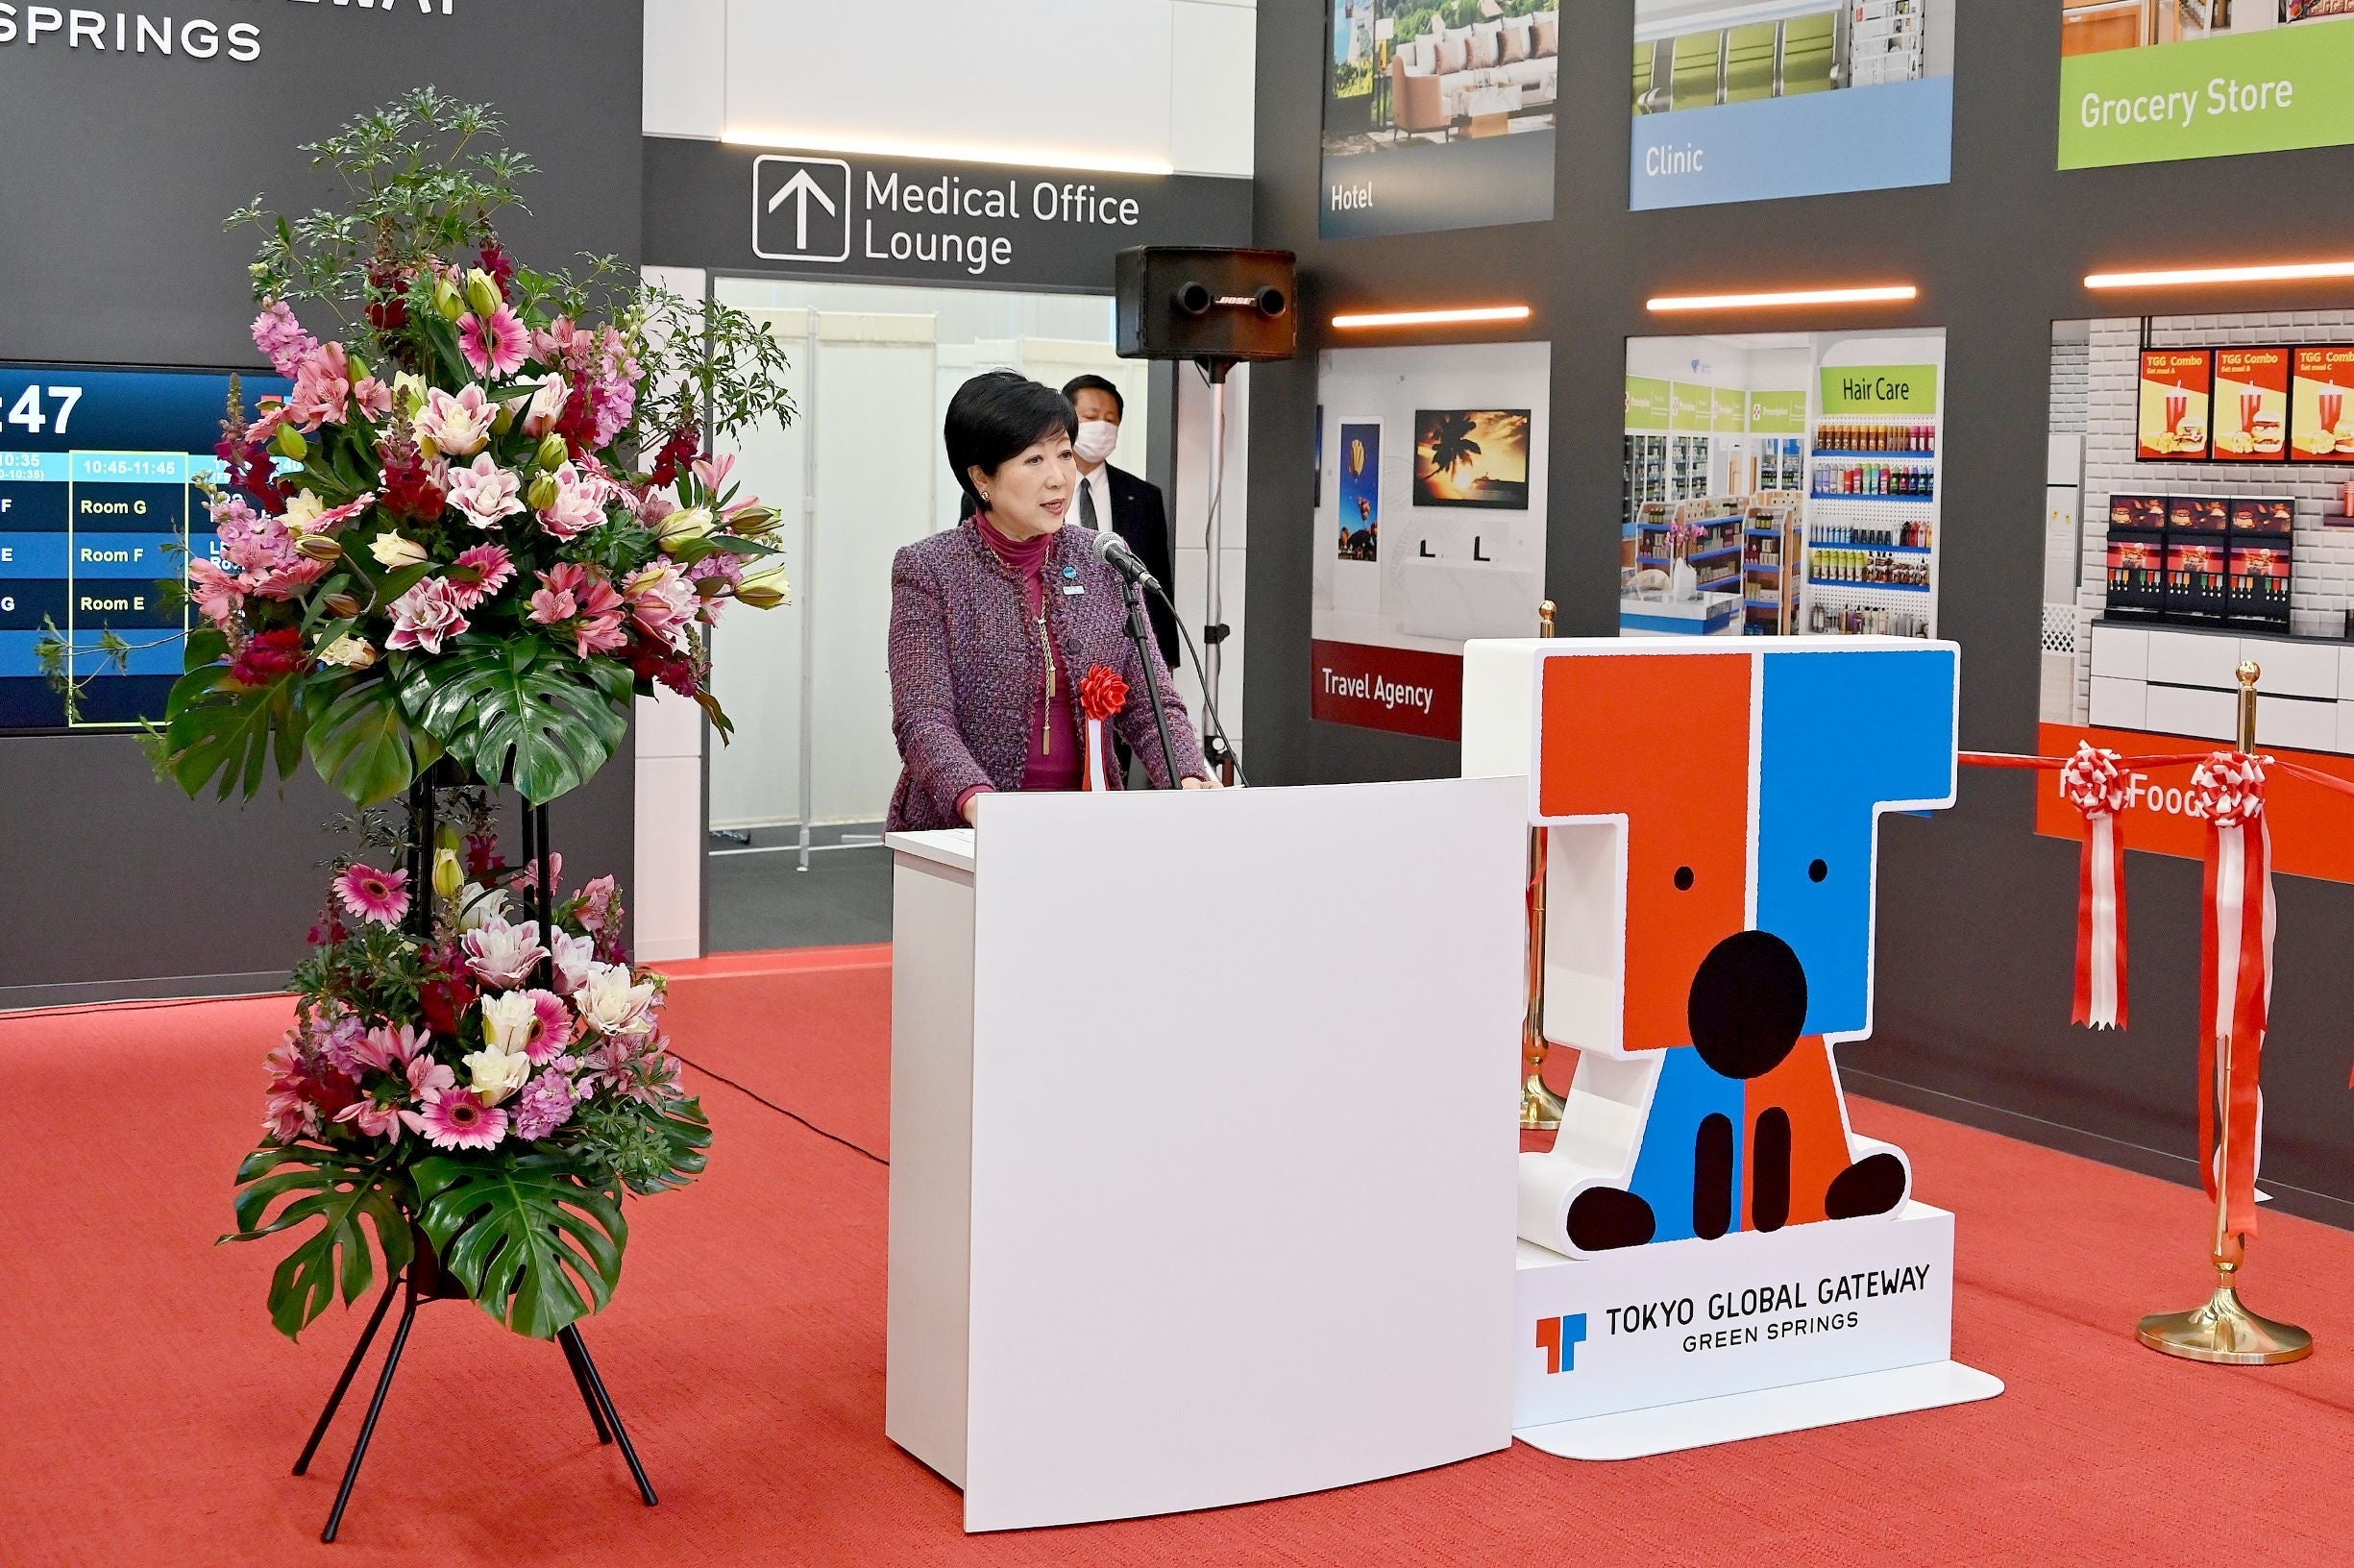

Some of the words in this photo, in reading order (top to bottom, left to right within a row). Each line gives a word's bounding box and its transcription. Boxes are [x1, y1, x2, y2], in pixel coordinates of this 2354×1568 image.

[2081, 90, 2199, 128] Grocery
[2207, 77, 2293, 115] Store
[1646, 141, 1704, 177] Clinic
[866, 170, 1020, 219] Medical
[1033, 182, 1140, 226] Office
[1331, 181, 1373, 211] Hotel
[866, 218, 1012, 275] Lounge
[1214, 296, 1256, 306] BOSE
[2146, 355, 2166, 366] TGG
[2170, 355, 2202, 366] Combo
[2221, 354, 2242, 364] TGG
[2244, 353, 2278, 364] Combo
[2300, 352, 2321, 362] TGG
[1843, 378, 1872, 400] Hair
[1876, 378, 1909, 400] Care
[84, 460, 176, 476] 10:45-11:45
[1, 499, 12, 513] F
[81, 500, 129, 514] Room
[134, 500, 147, 515] G
[1, 548, 13, 562] E
[81, 549, 129, 563] Room
[134, 549, 144, 563] F
[1, 597, 15, 612] G
[81, 597, 129, 611] Room
[134, 597, 145, 611] E
[1322, 667, 1370, 699] Travel
[1373, 674, 1433, 714] Agency
[1606, 1297, 1694, 1335] TOKYO
[1708, 1282, 1807, 1321] GLOBAL
[1818, 1263, 1930, 1305] GATEWAY
[1682, 1326, 1758, 1353] GREEN
[1767, 1311, 1858, 1340] SPRINGS
